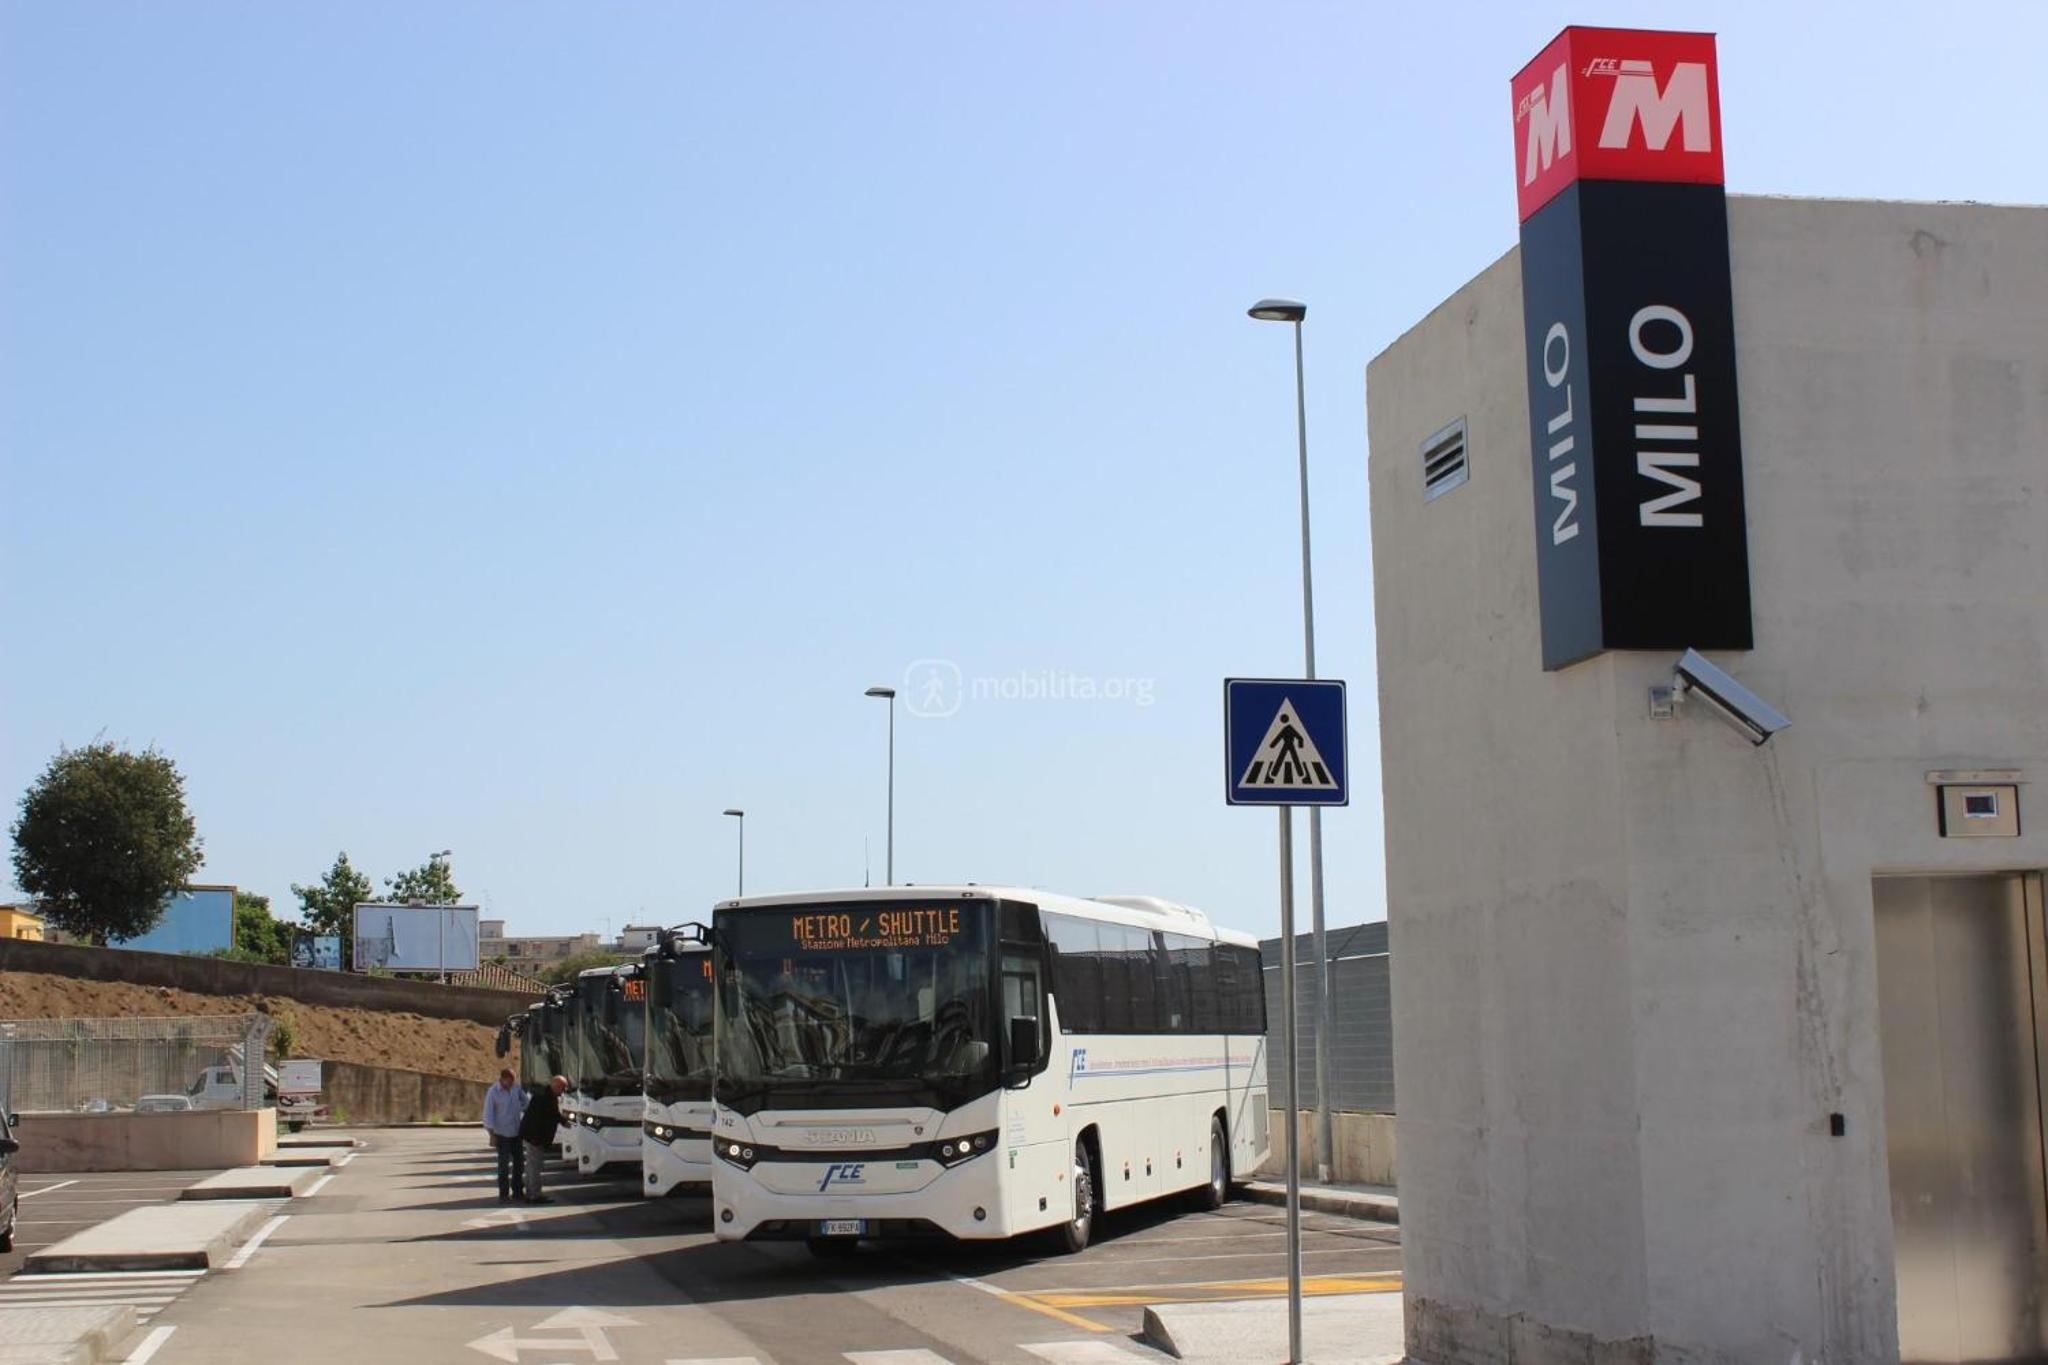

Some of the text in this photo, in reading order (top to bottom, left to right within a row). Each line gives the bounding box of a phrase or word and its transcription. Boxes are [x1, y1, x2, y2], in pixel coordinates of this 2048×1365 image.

[1524, 62, 1571, 187] M
[1597, 59, 1711, 153] M
[1544, 322, 1579, 546] MILO
[1629, 305, 1703, 527] MILO
[792, 914, 850, 940] METRO
[878, 910, 959, 935] SHUTTLE
